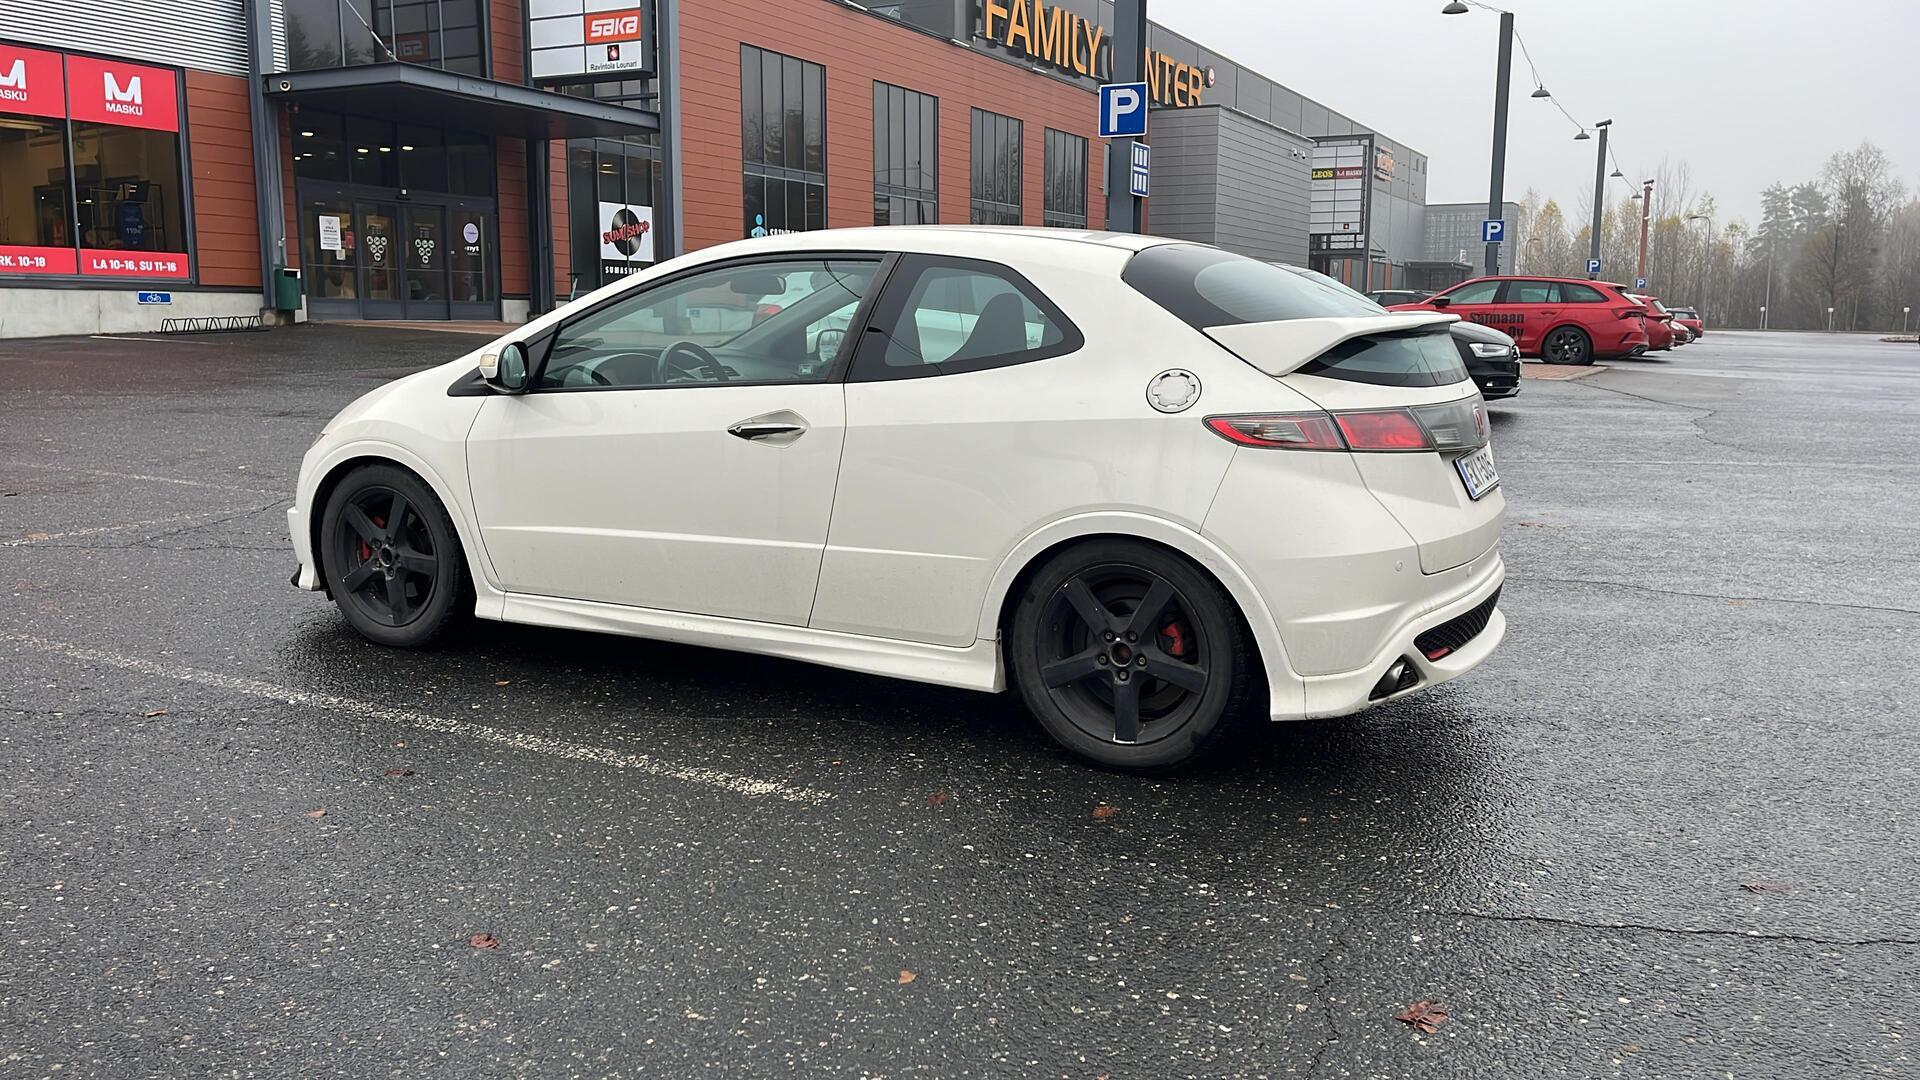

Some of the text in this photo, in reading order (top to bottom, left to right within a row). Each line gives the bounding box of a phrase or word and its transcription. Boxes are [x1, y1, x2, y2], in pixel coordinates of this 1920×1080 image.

[986, 0, 1102, 77] FAMILY
[105, 102, 143, 116] MASKU
[1109, 88, 1140, 132] P
[1486, 222, 1501, 240] P
[18, 255, 46, 268] 10-18
[93, 259, 177, 272] LA 10-16, SU 11-16
[1589, 261, 1600, 271] P
